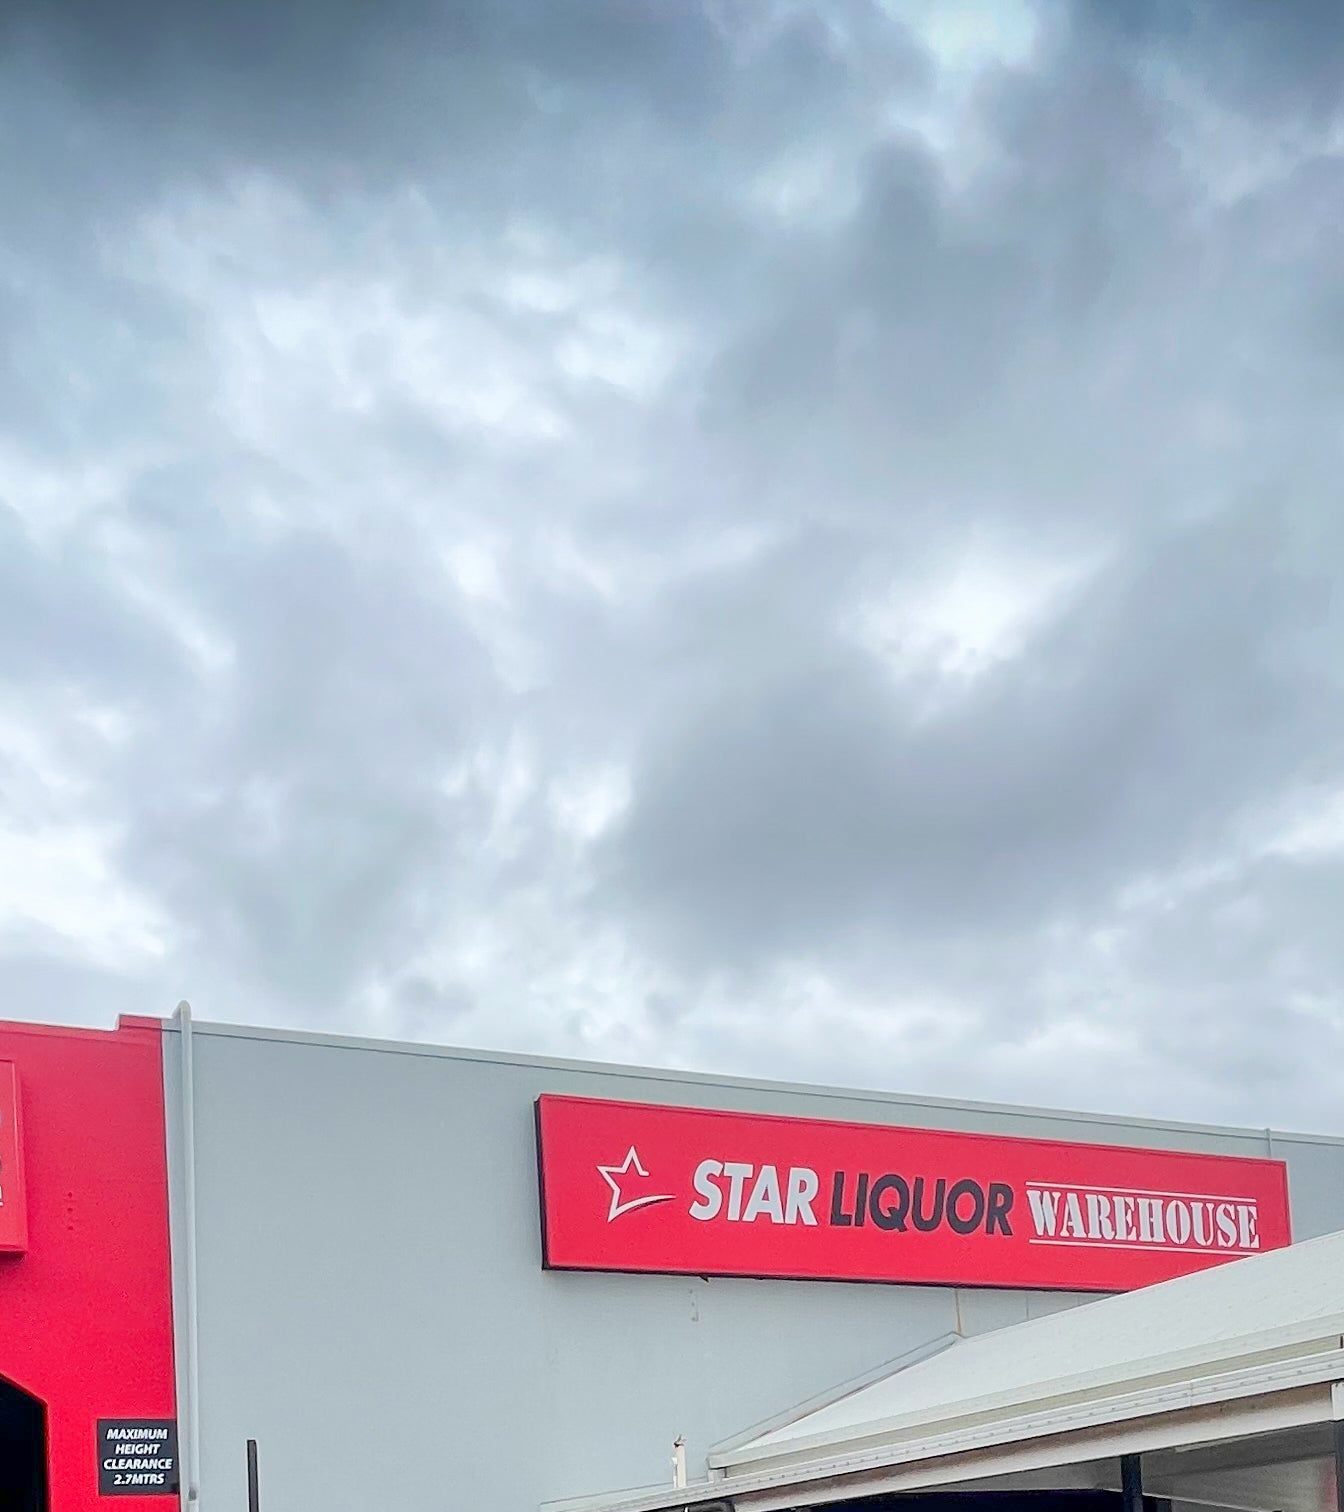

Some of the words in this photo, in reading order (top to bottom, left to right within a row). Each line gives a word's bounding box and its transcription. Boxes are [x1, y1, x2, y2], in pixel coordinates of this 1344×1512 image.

[688, 1159, 819, 1227] STAR
[830, 1171, 1013, 1237] LIQUOR
[1027, 1189, 1260, 1250] WAREHOUSE
[106, 1428, 168, 1440] MAXIMUM
[115, 1443, 160, 1455] HEIGHT
[103, 1458, 173, 1470] CLEARANCE
[113, 1473, 165, 1485] 2.7MTRS
